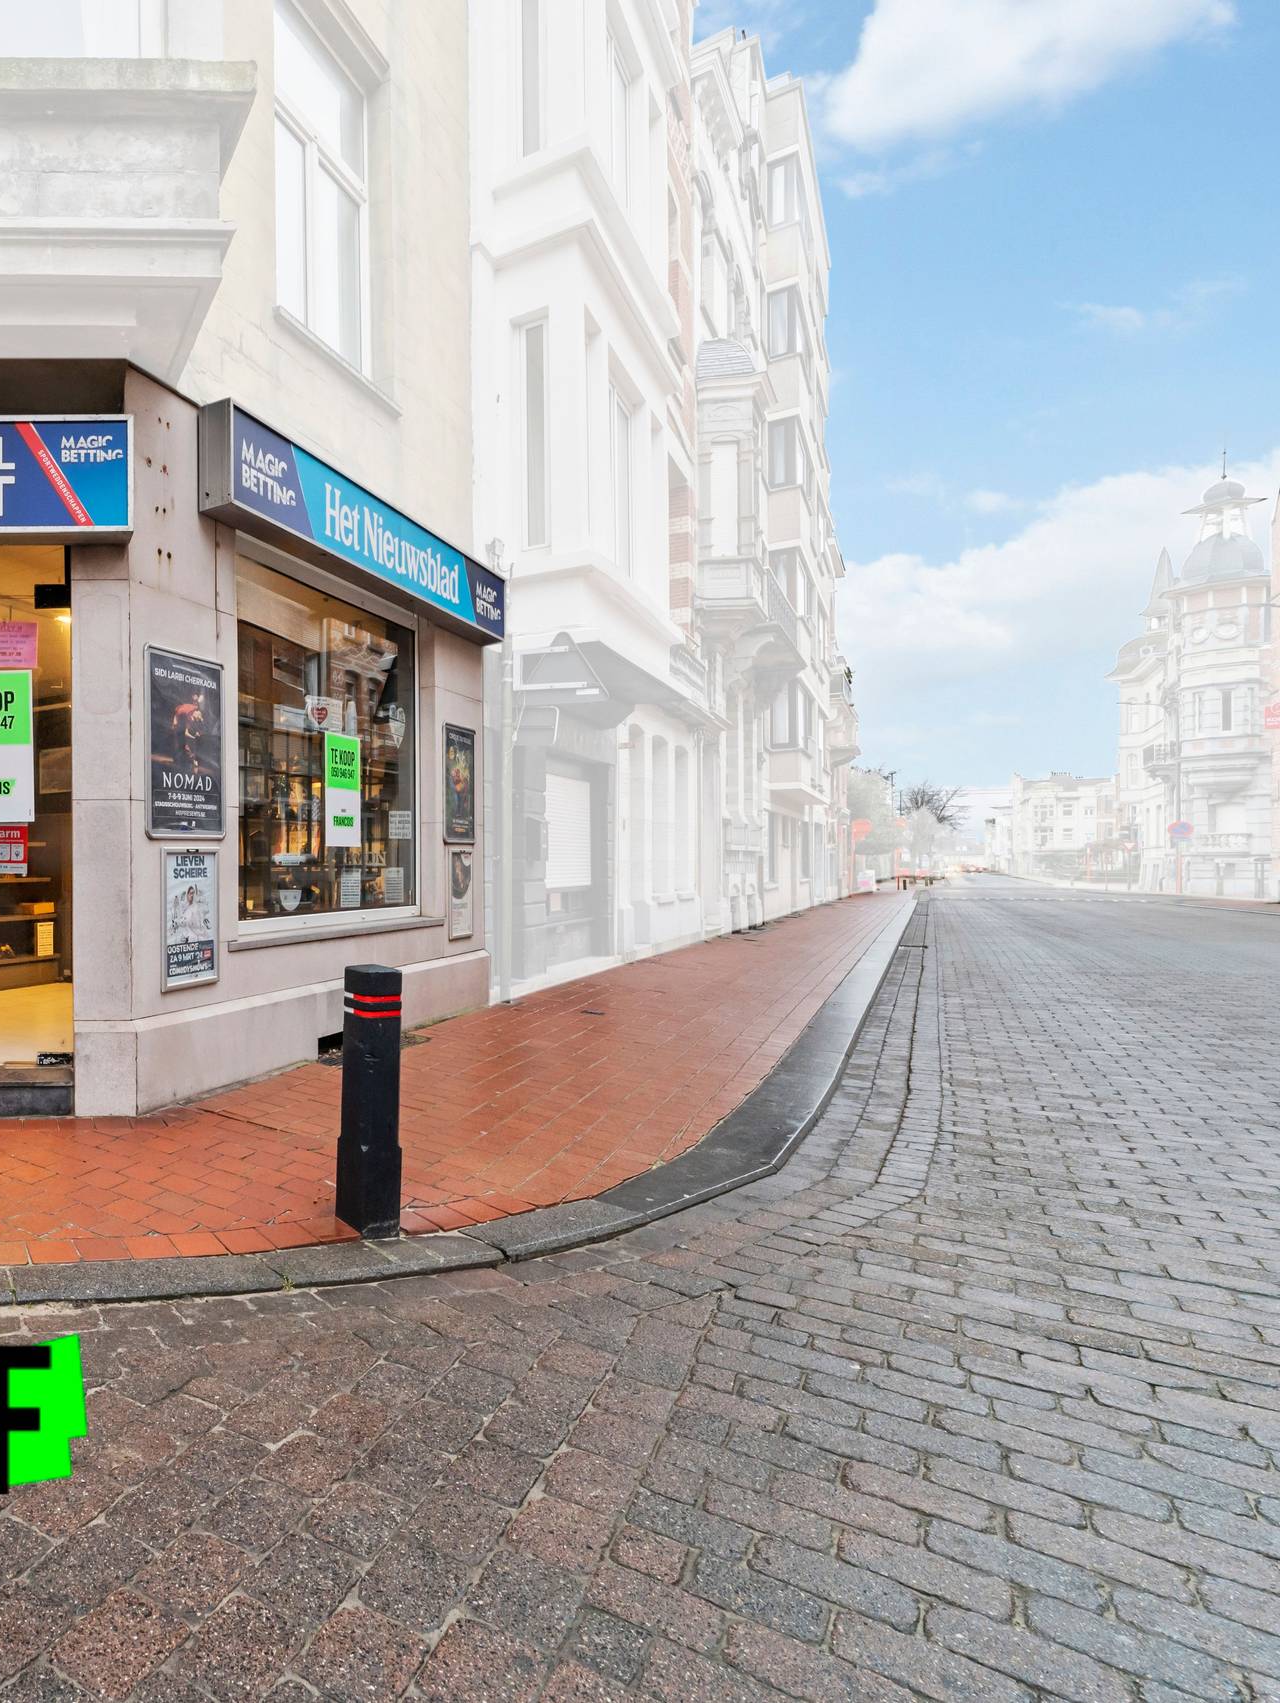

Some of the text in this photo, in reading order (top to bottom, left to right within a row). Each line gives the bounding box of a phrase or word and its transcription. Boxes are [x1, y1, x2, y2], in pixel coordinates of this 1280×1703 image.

[60, 435, 113, 449] MAGIC
[60, 449, 123, 463] BETTING
[241, 437, 288, 478] MAGIC
[37, 449, 87, 524] SPORTWEDDENSCHAPPEN
[241, 464, 297, 507] BETTING
[324, 482, 460, 605] Het Nieuwsblad
[476, 580, 498, 603] MAGIC
[476, 597, 501, 621] BETTING
[154, 667, 167, 678] SIDI
[168, 670, 185, 682] LARBI
[330, 747, 355, 767] TE KOOP
[162, 771, 212, 791] NOMAD
[333, 815, 354, 827] FRANCOIS
[175, 855, 205, 867] LIEVEN
[173, 867, 208, 879] SCHEIRE
[168, 942, 199, 954] OOSTENDE
[170, 954, 178, 963] ZA
